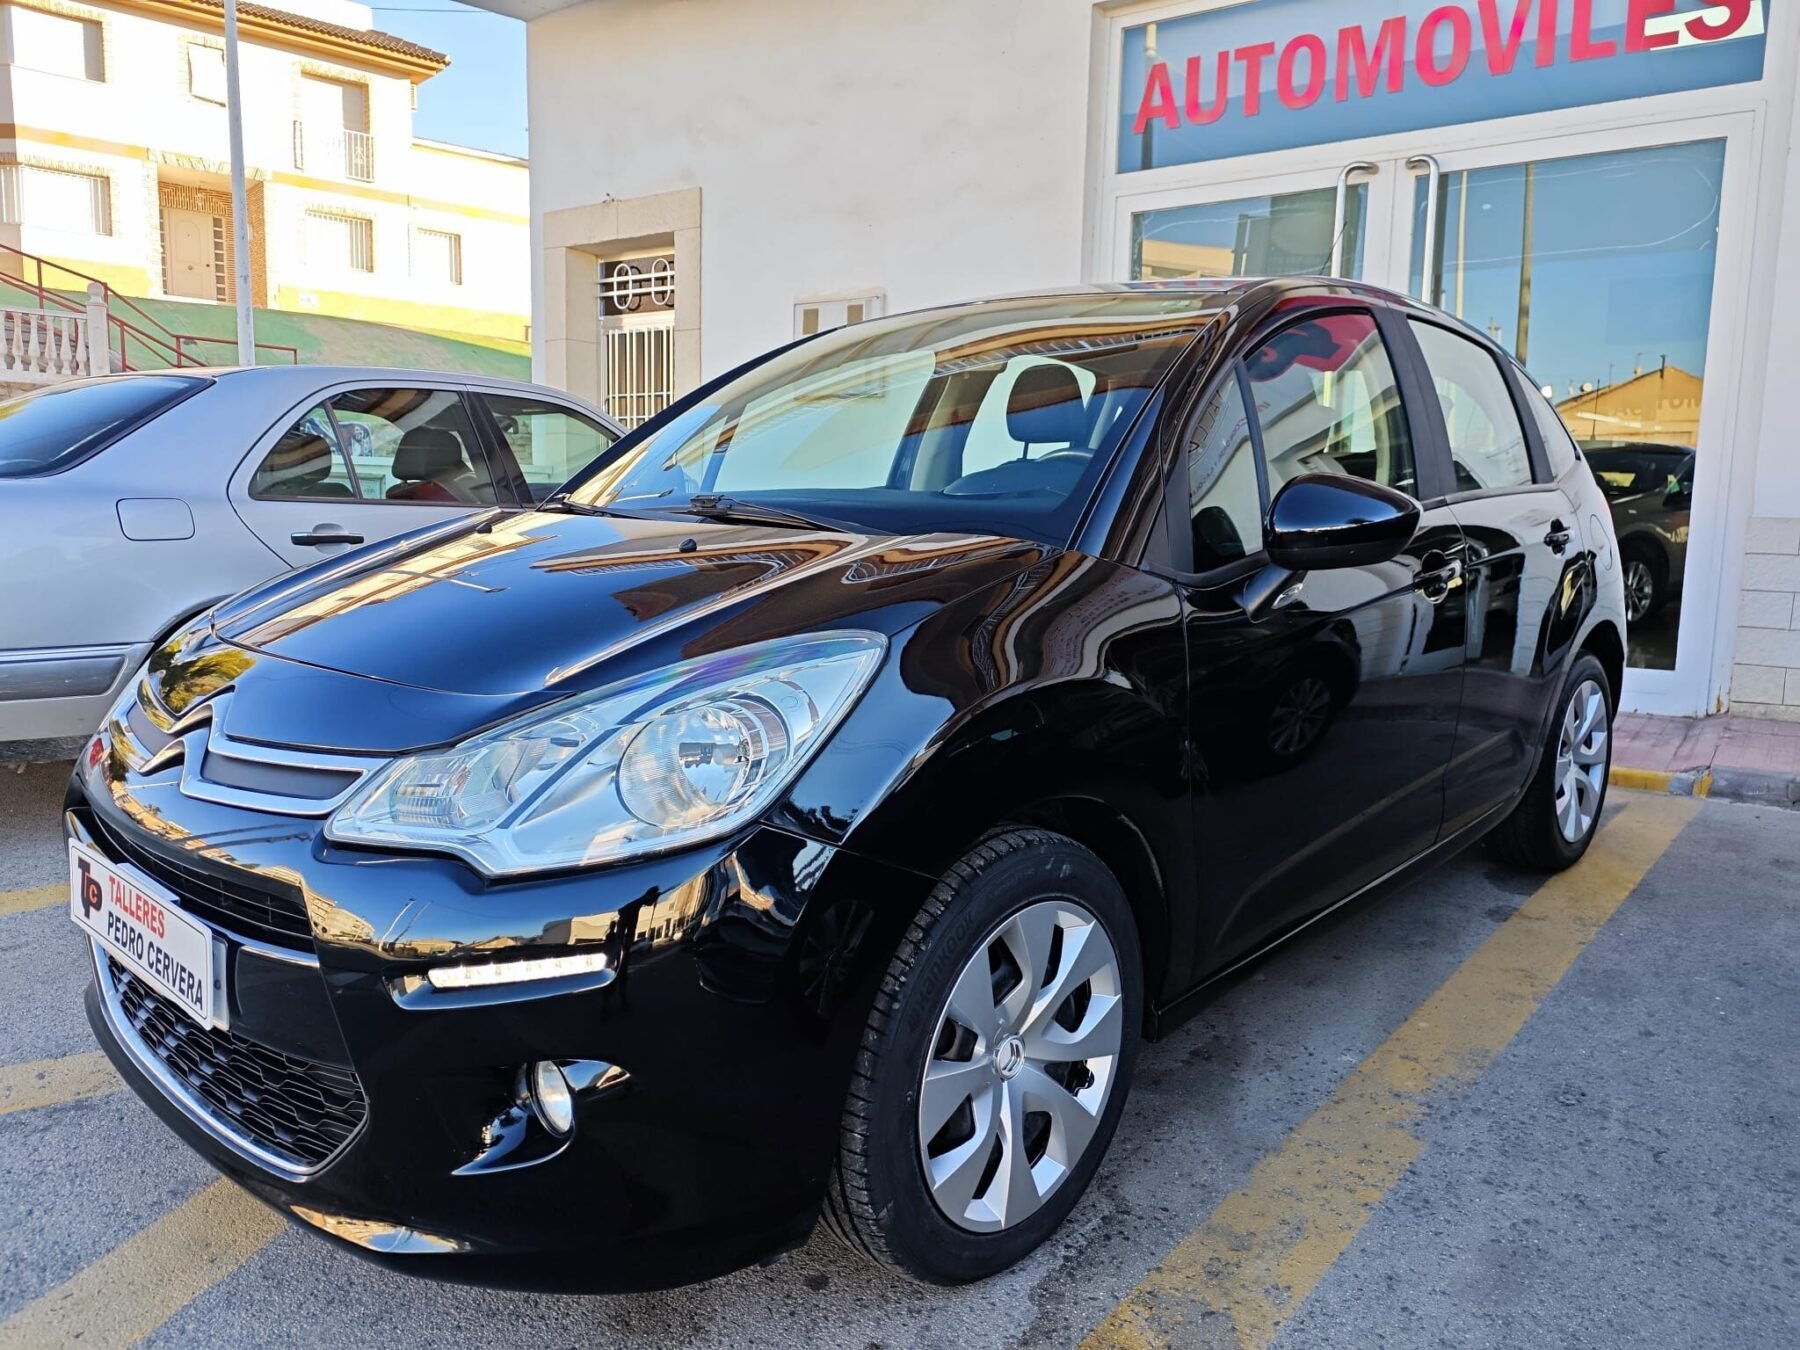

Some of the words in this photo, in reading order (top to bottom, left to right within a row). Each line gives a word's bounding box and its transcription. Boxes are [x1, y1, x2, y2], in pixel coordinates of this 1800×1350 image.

[107, 910, 144, 961] PEDRO
[108, 875, 166, 940] TALLERES
[147, 940, 204, 1011] CERVERA
